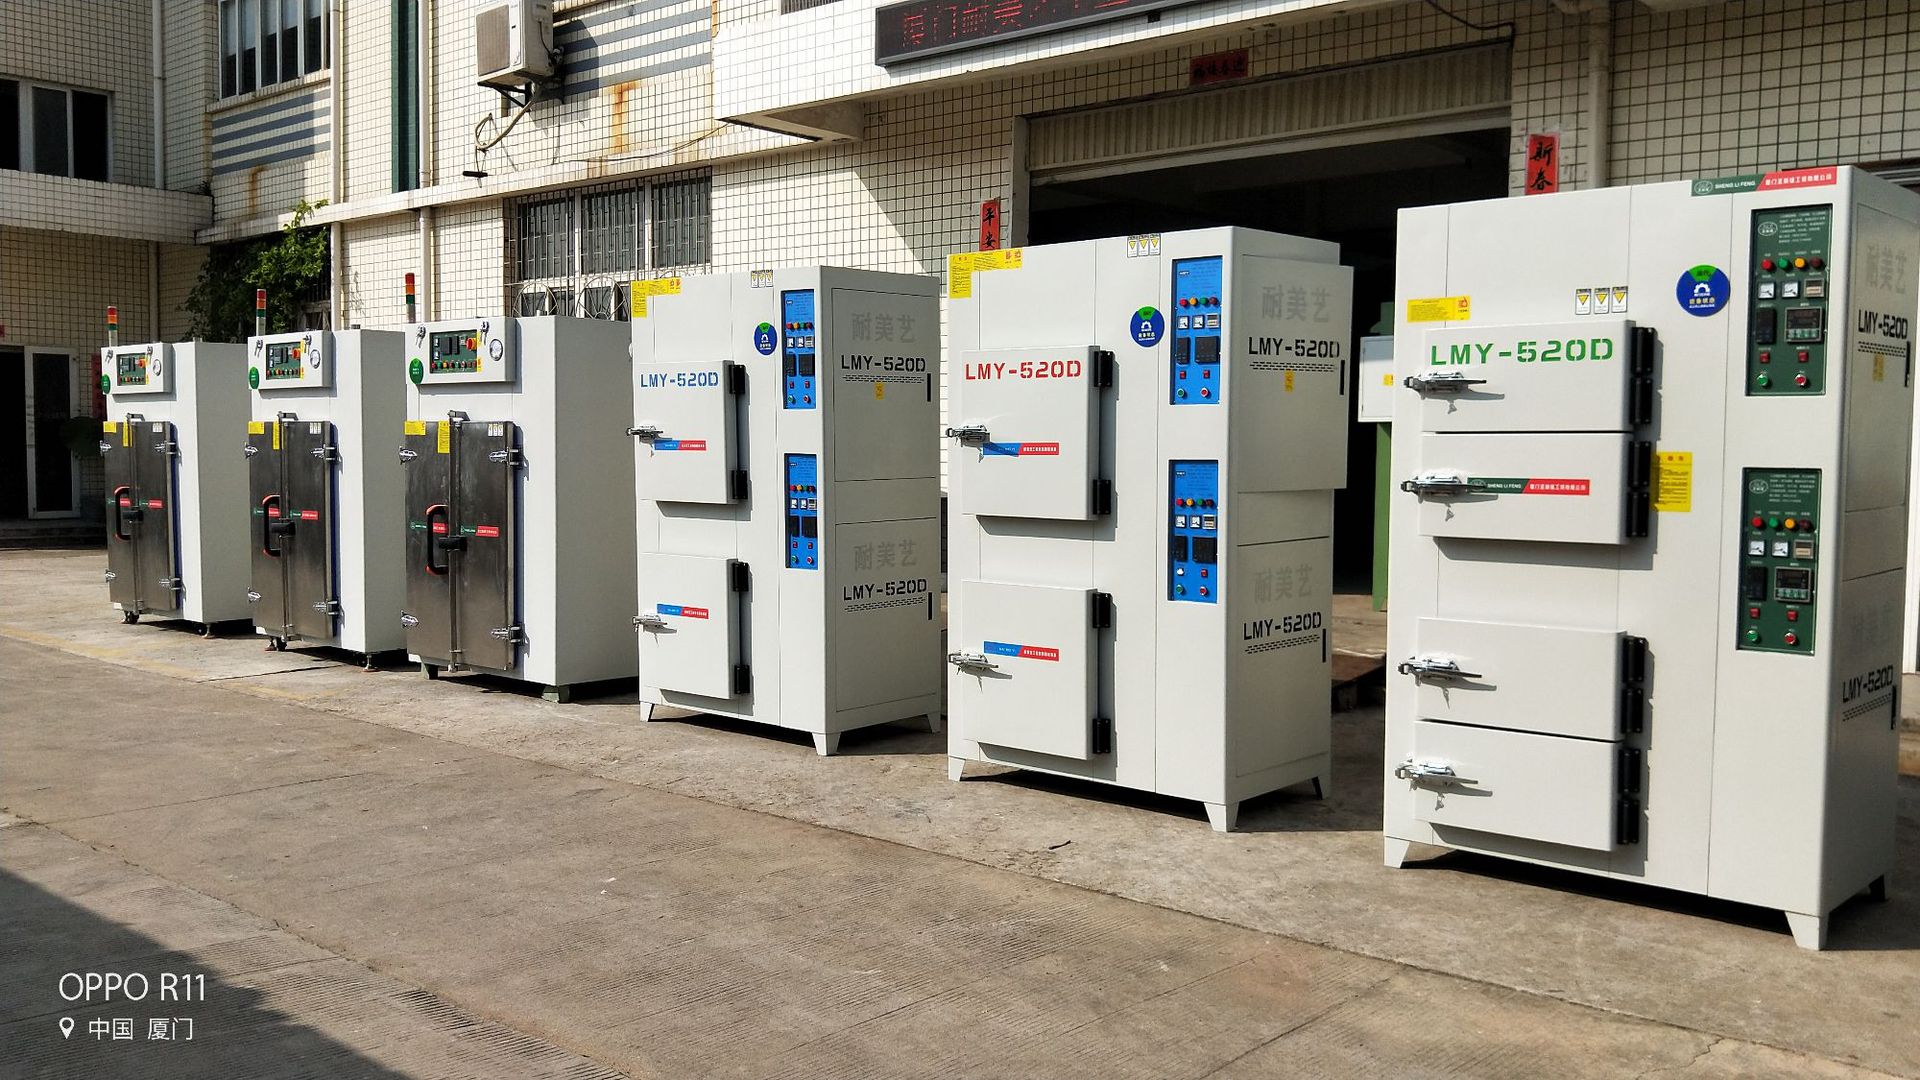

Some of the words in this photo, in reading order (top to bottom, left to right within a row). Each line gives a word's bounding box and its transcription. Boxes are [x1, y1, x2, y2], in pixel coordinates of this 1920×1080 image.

[1530, 141, 1553, 191] 新春
[1262, 285, 1330, 323] 耐美艺
[851, 312, 916, 343] 耐美艺
[1858, 309, 1908, 339] LMY-520D
[1249, 336, 1340, 358] LMY-520D
[1431, 338, 1613, 366] LMY-520D
[841, 354, 926, 372] LMY-520D
[965, 360, 1081, 380] LMY-520D
[640, 372, 719, 388] LMY-520D
[853, 539, 917, 572] 耐美艺
[843, 578, 927, 601] LMY-520D
[1243, 611, 1322, 641] LMY-520D
[1842, 664, 1894, 703] LMY-520D
